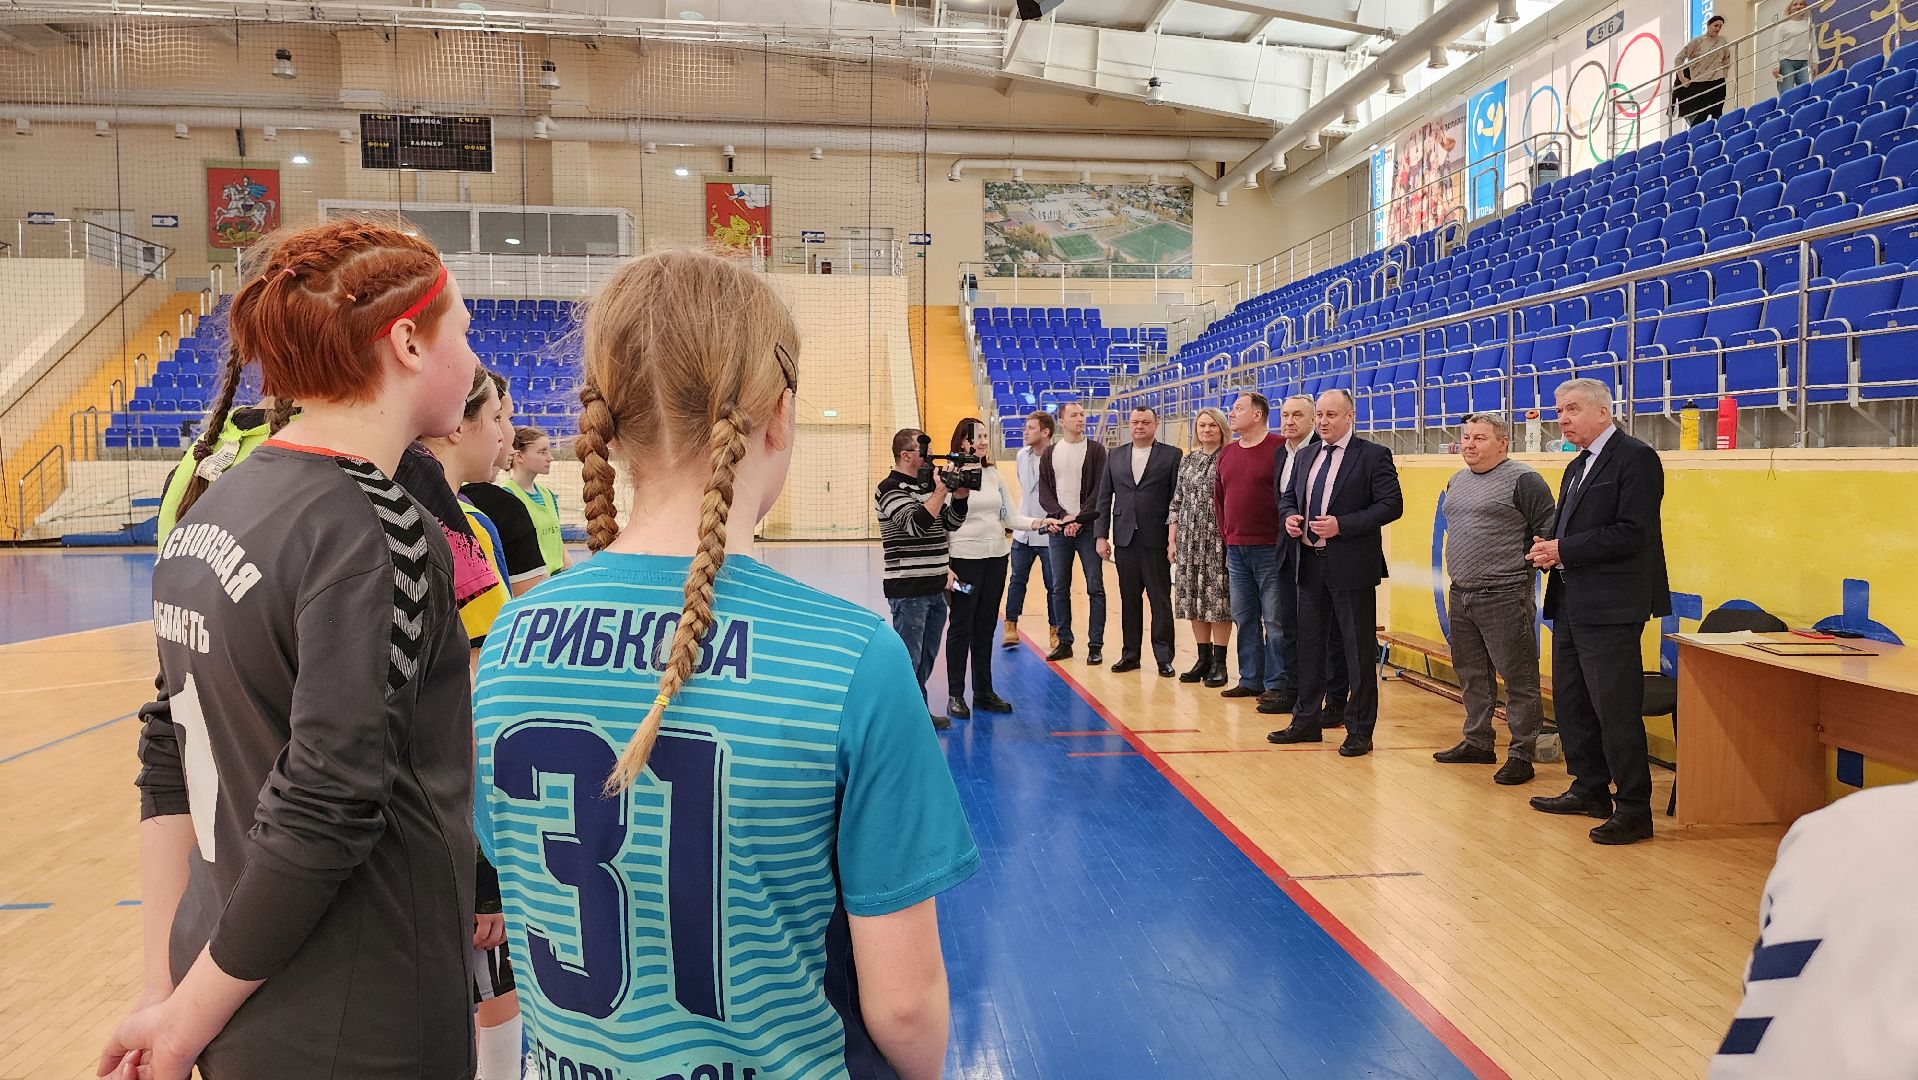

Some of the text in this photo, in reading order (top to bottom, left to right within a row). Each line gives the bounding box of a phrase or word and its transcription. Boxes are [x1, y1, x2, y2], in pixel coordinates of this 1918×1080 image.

[1597, 21, 1614, 39] 5 6
[154, 523, 263, 604] СКОВСКАЯ
[501, 607, 749, 680] ГРИБКОВА
[493, 717, 726, 1022] 31
